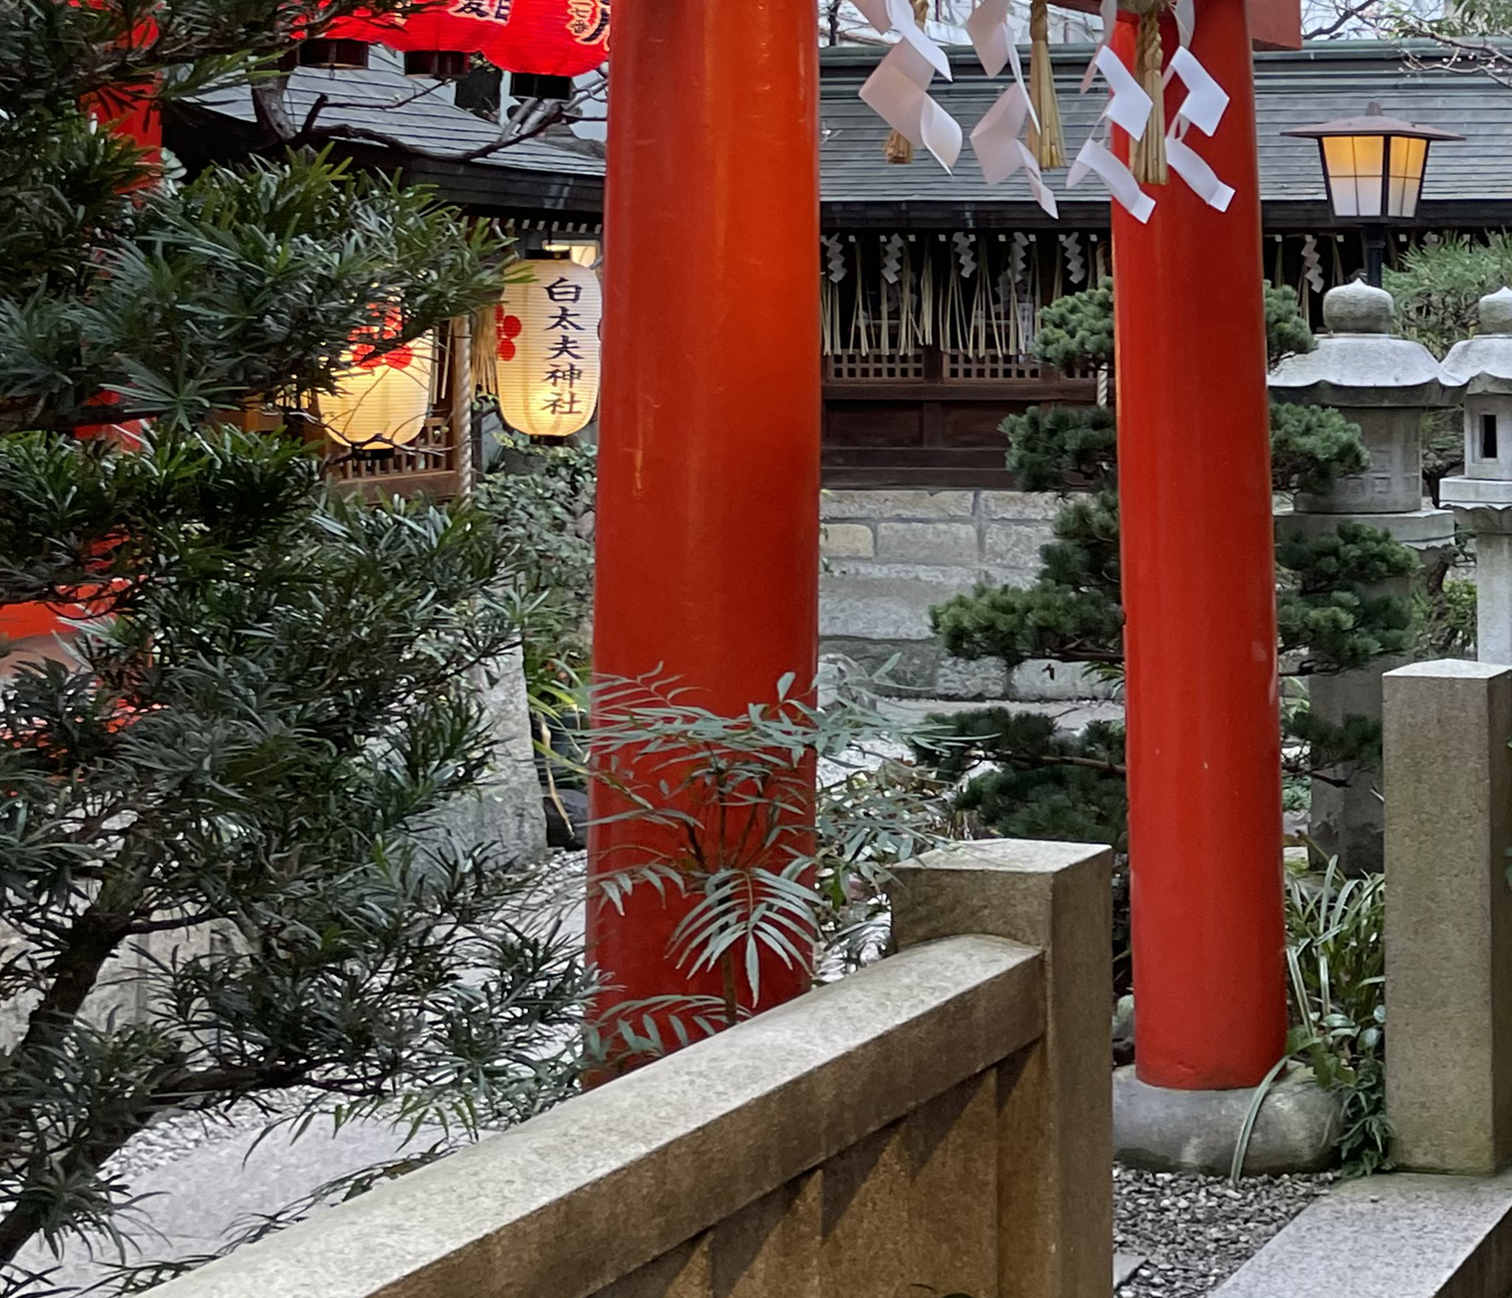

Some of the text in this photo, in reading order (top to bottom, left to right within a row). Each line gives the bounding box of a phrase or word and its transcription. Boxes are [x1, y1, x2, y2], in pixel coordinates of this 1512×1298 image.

[541, 276, 586, 415] 白太夫神社
